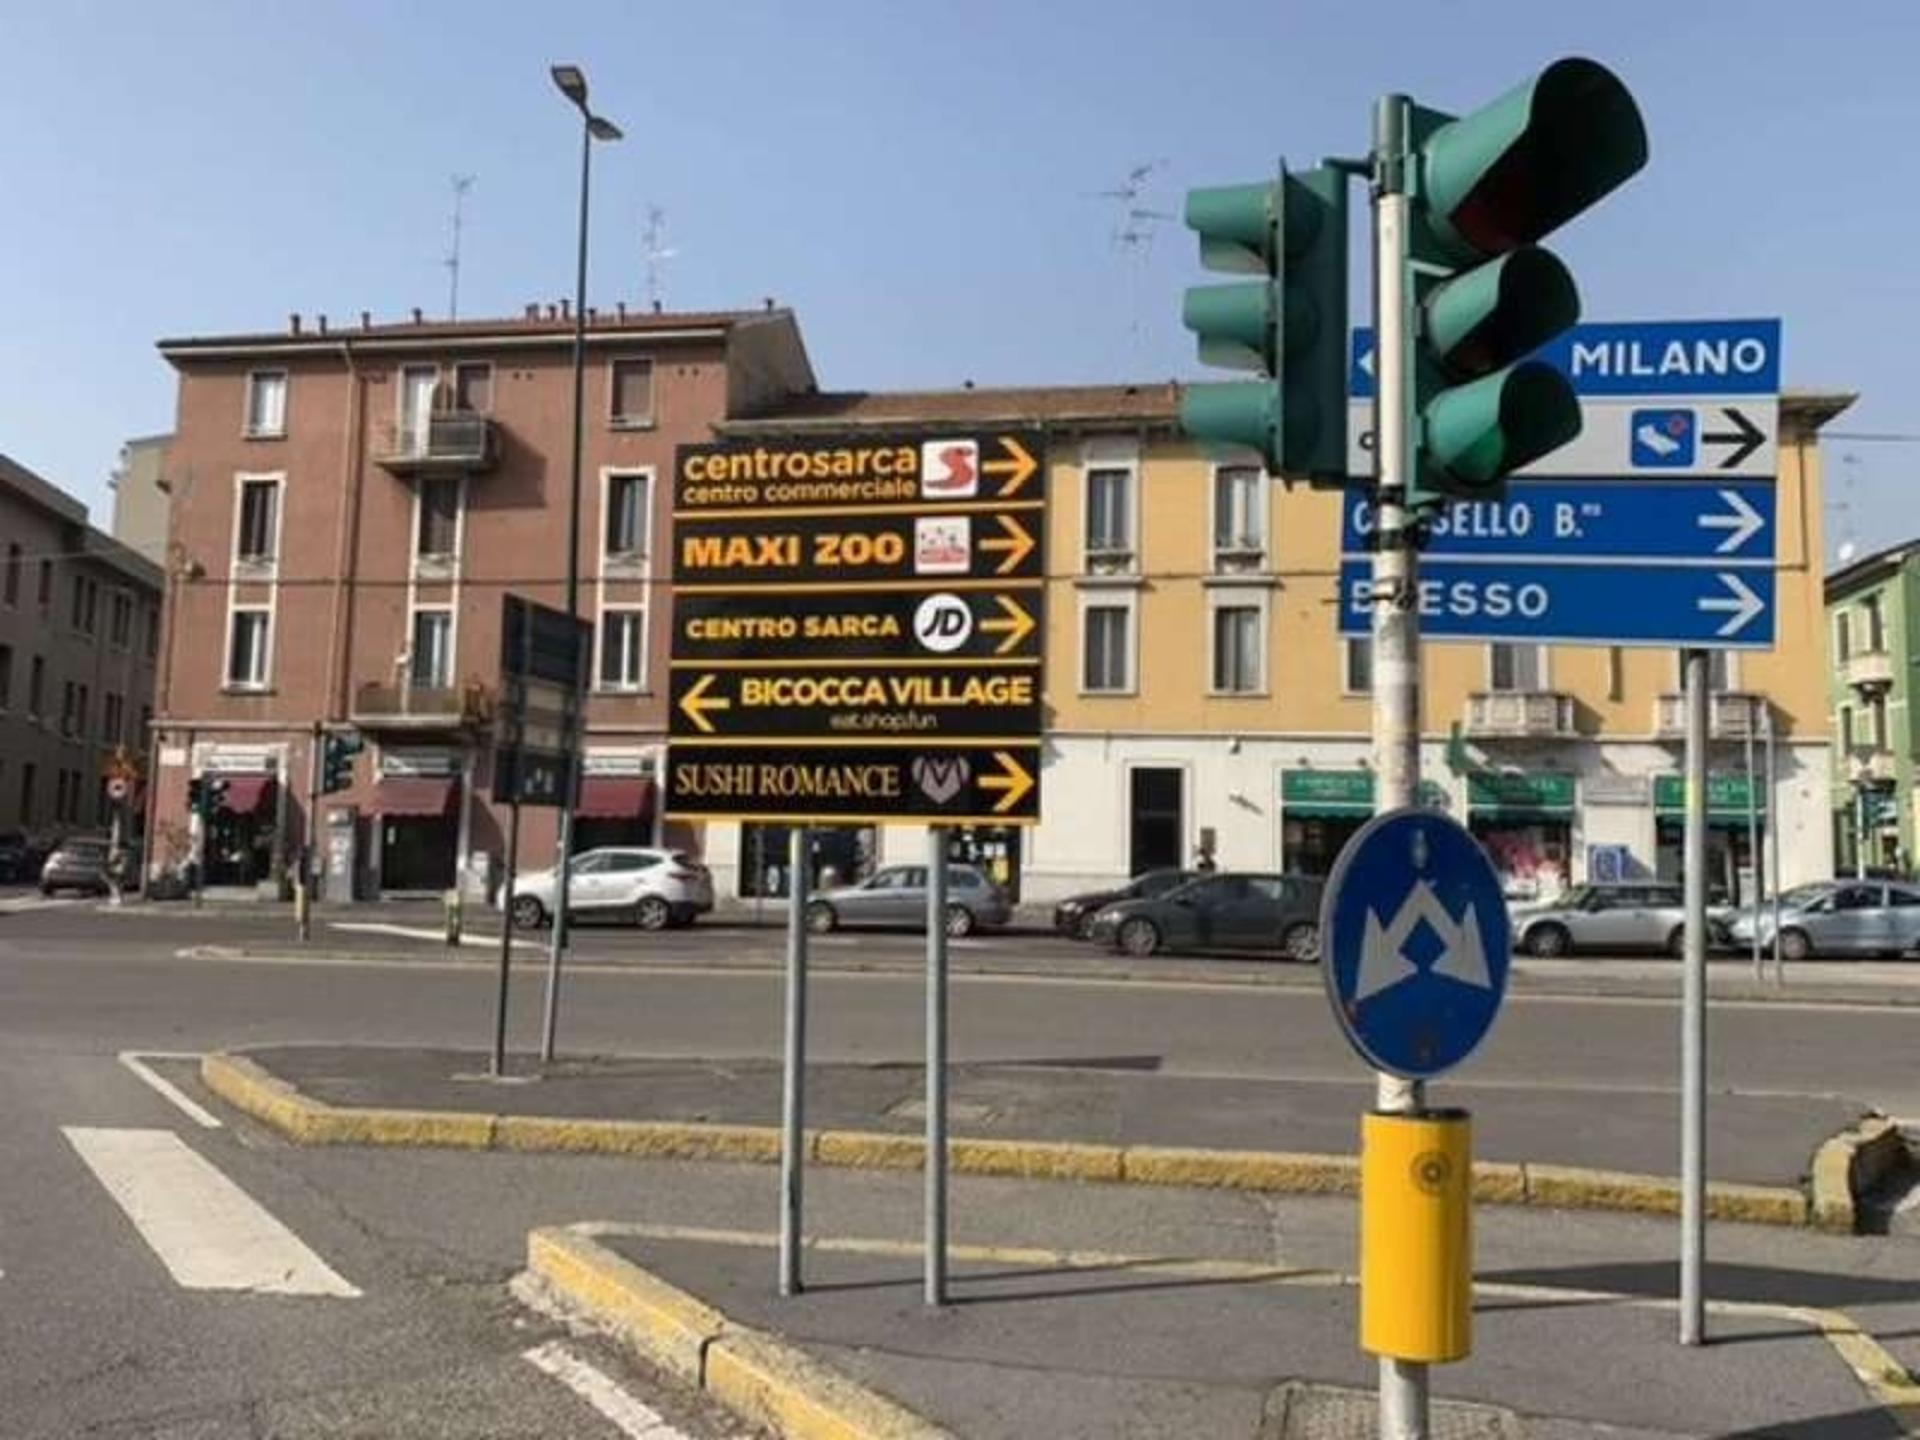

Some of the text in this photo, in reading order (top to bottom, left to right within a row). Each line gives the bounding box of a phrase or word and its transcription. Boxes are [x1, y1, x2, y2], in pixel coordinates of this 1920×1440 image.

[1571, 337, 1767, 376] MILANO
[683, 447, 917, 481] centrosarca
[683, 477, 917, 503] centro commerciale
[1353, 501, 1531, 537] CSELLO
[683, 534, 904, 567] MAXI ZOO
[1351, 580, 1549, 617] BESSO
[686, 615, 900, 640] CENTRO SARCA
[740, 677, 1033, 706] BICOCCA VILLAGE
[675, 764, 901, 797] SUSHI ROMANCE
